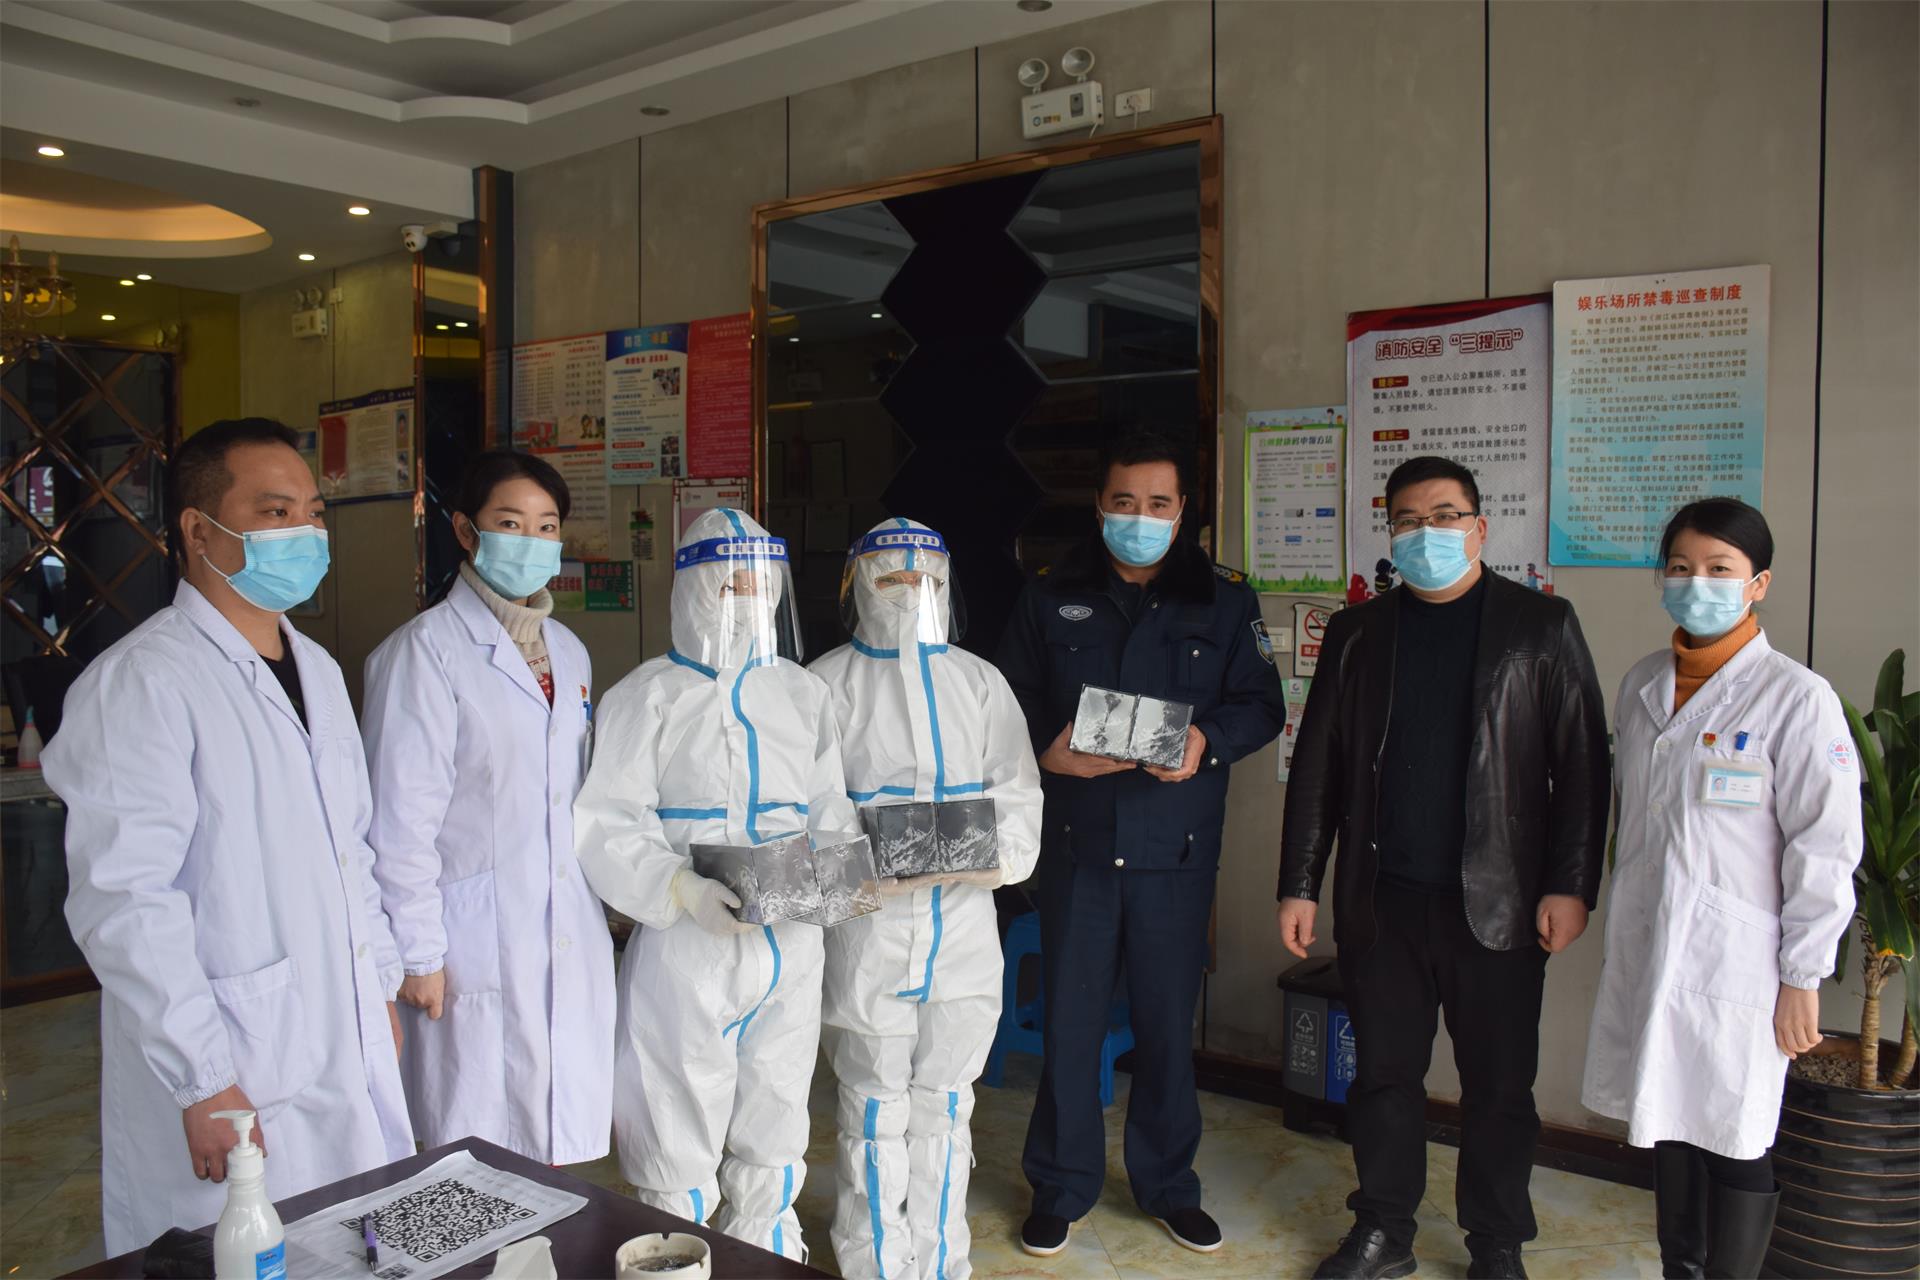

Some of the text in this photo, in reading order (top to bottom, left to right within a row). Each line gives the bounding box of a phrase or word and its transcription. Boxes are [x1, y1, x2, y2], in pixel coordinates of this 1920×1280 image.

[1578, 284, 1742, 311] 娱乐场所禁毒巡查制度
[1376, 329, 1524, 361] 消防安全“三提示”
